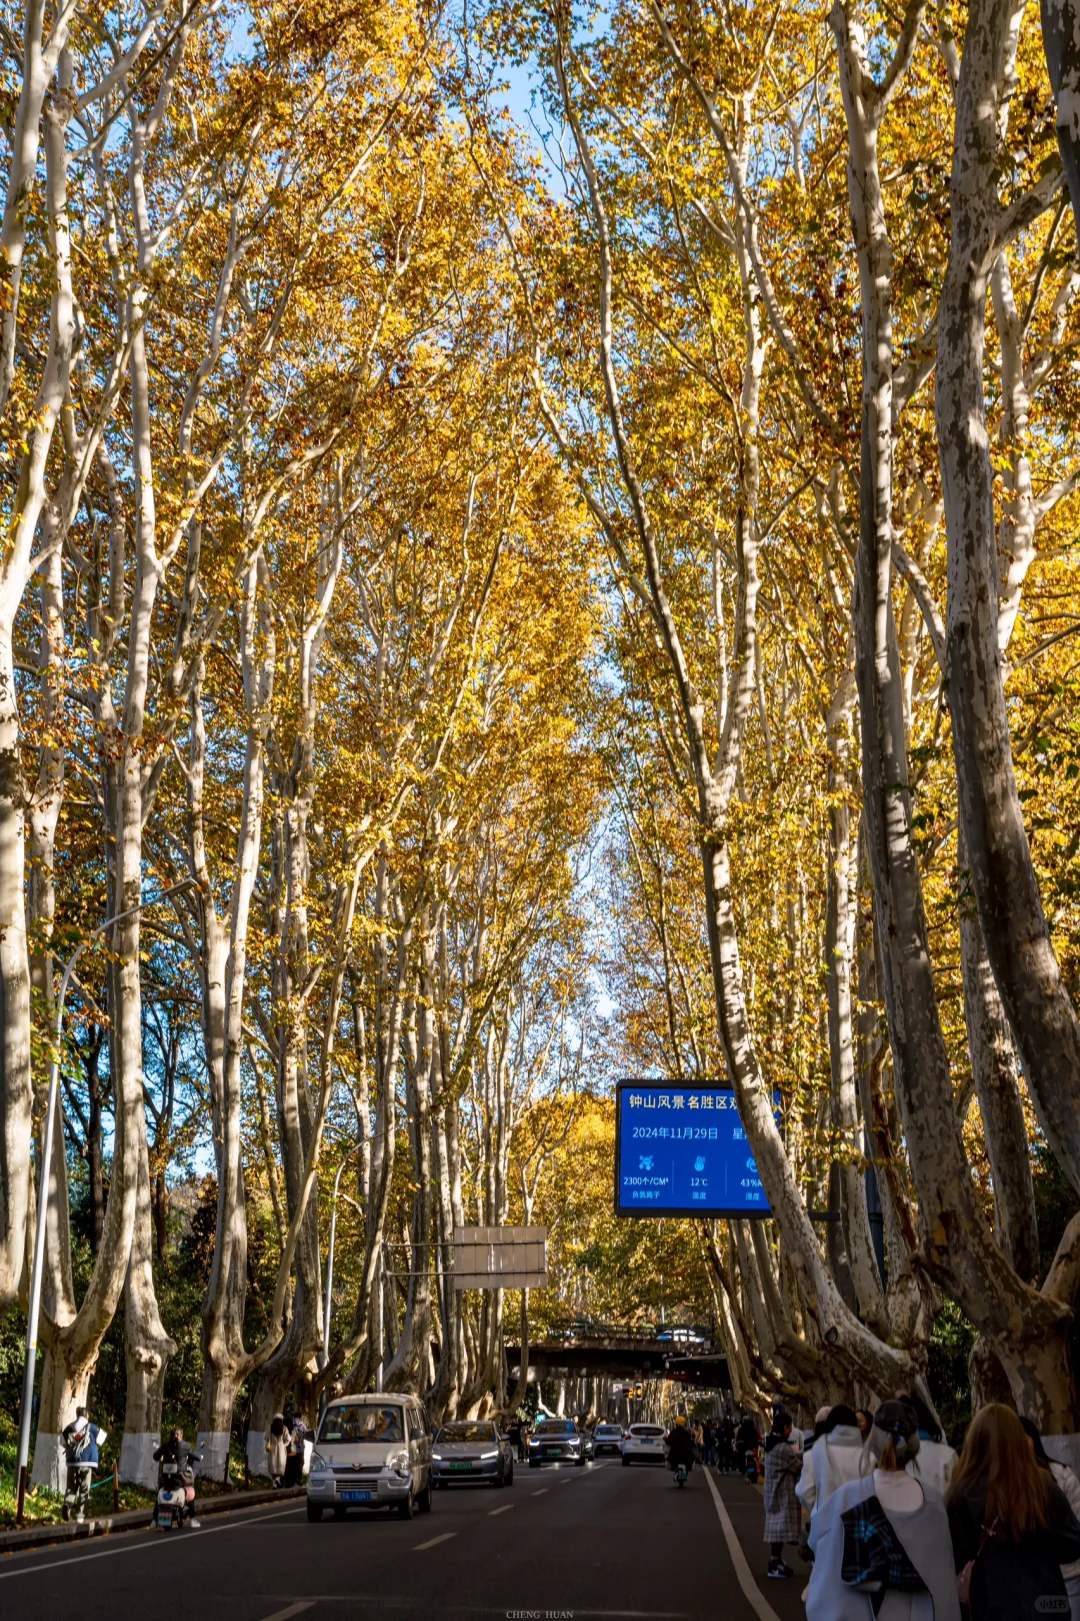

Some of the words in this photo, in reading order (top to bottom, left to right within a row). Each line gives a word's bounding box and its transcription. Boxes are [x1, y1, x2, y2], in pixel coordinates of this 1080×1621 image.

[632, 1126, 718, 1140] 2024年11月29日
[732, 1127, 747, 1140] 星
